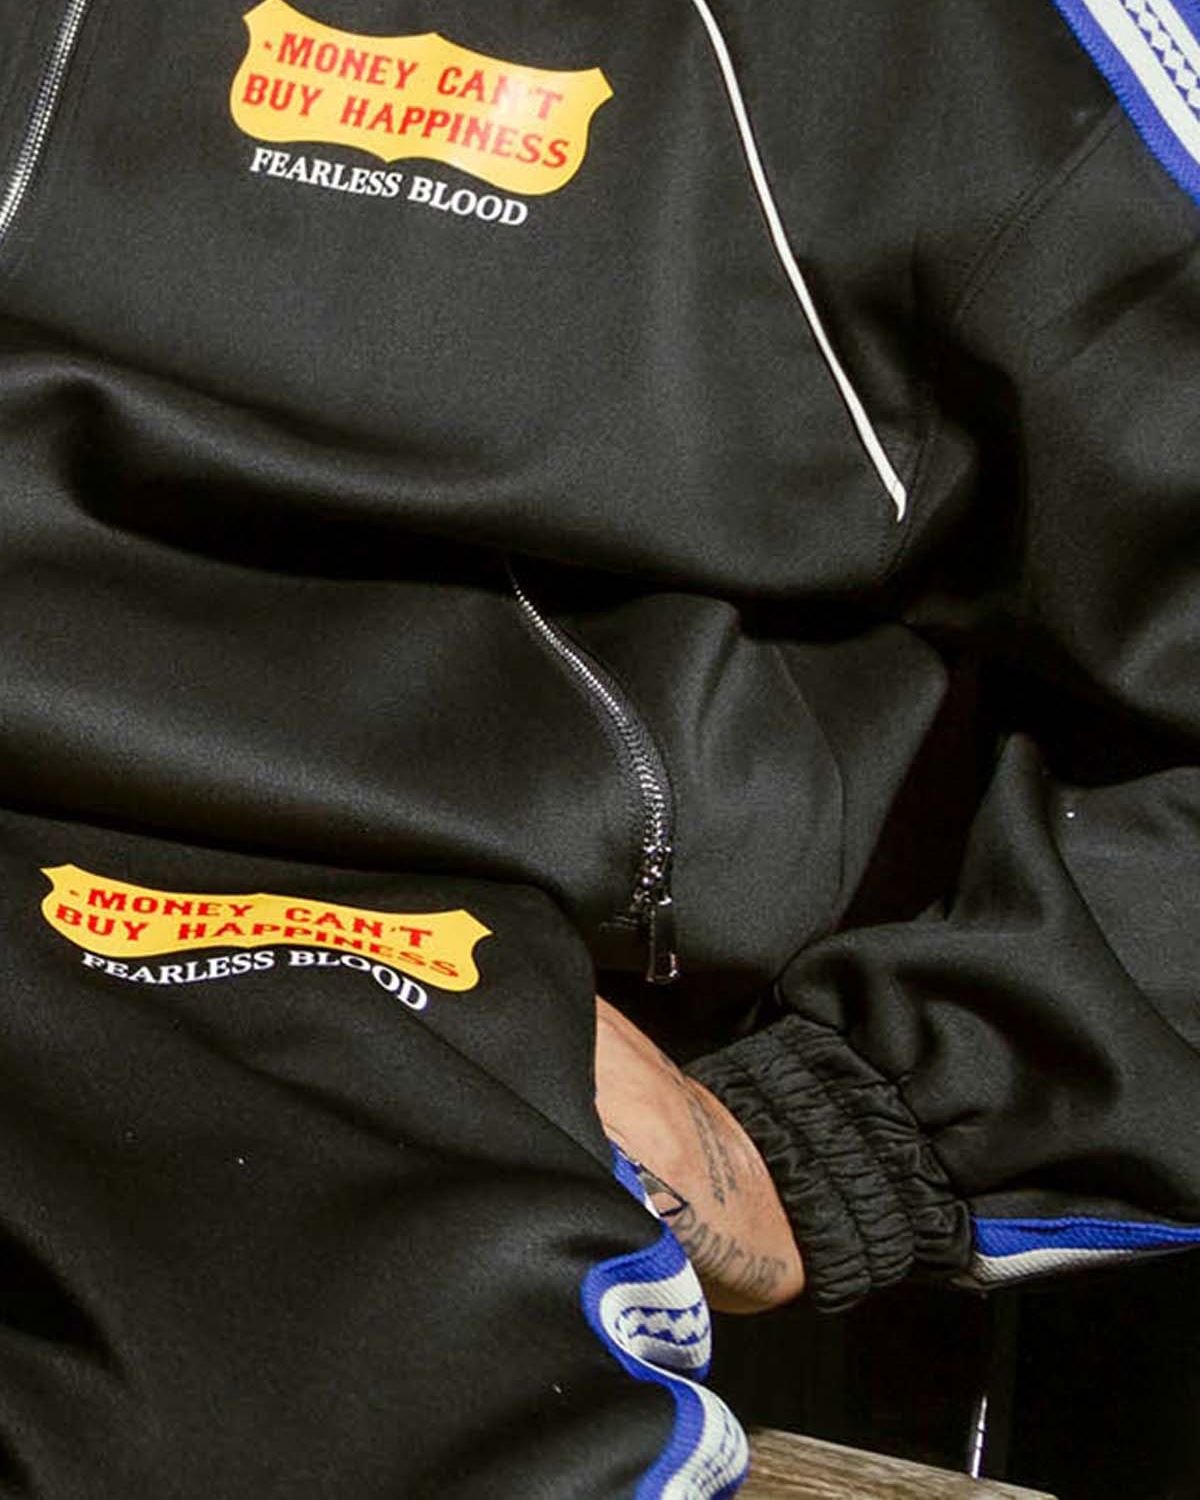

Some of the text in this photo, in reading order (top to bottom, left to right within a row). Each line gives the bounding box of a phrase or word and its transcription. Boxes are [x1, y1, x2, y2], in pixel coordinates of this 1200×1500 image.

[242, 74, 569, 169] BUY HAPPINESS
[250, 148, 528, 226] FEARLESS BLOOD
[55, 904, 459, 977] BUY HAPPINESS
[285, 907, 433, 948] CAN'T
[82, 950, 428, 1011] FEARLESS BLOOD
